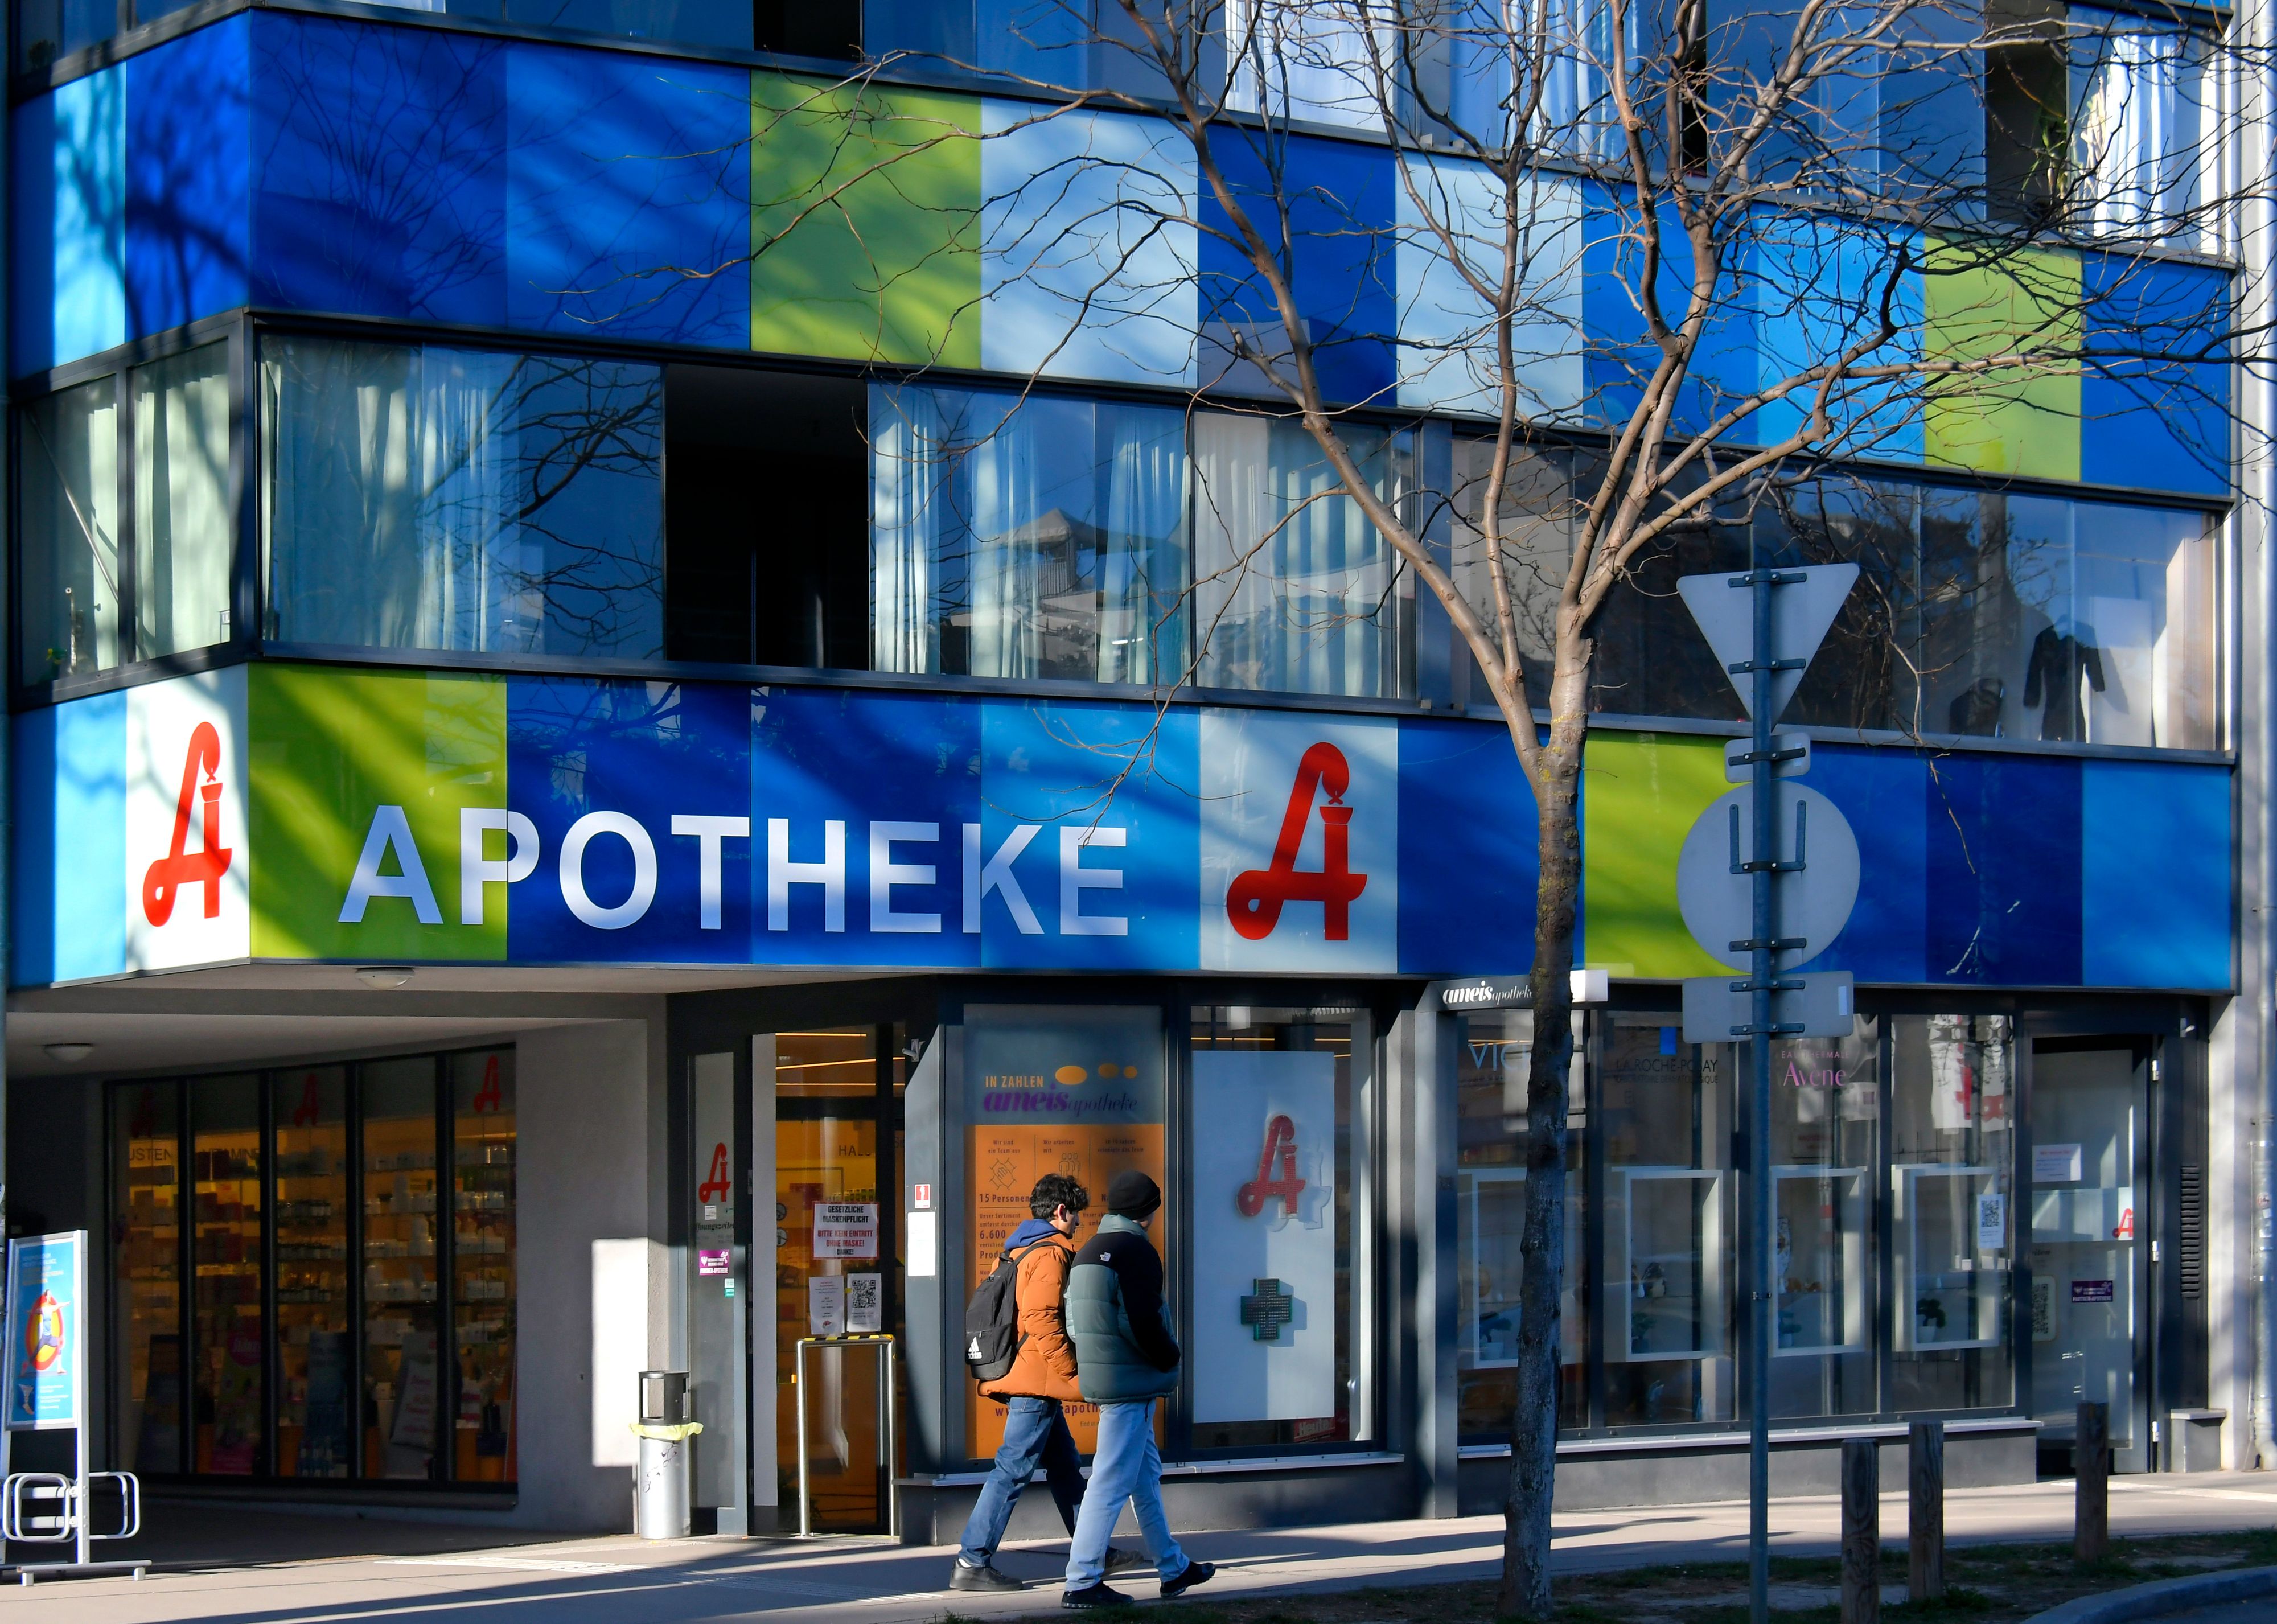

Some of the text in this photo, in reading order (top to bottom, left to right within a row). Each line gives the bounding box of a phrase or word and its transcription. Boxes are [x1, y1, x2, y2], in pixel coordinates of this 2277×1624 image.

[338, 804, 1129, 937] APOTHEKE
[1634, 1058, 1718, 1072] ROCHE-POAY
[1783, 1060, 1847, 1087] Avène
[985, 1075, 1043, 1088] IN ZAHLEN
[979, 1193, 1030, 1203] 15 Personen
[979, 1230, 1006, 1239] 6.600
